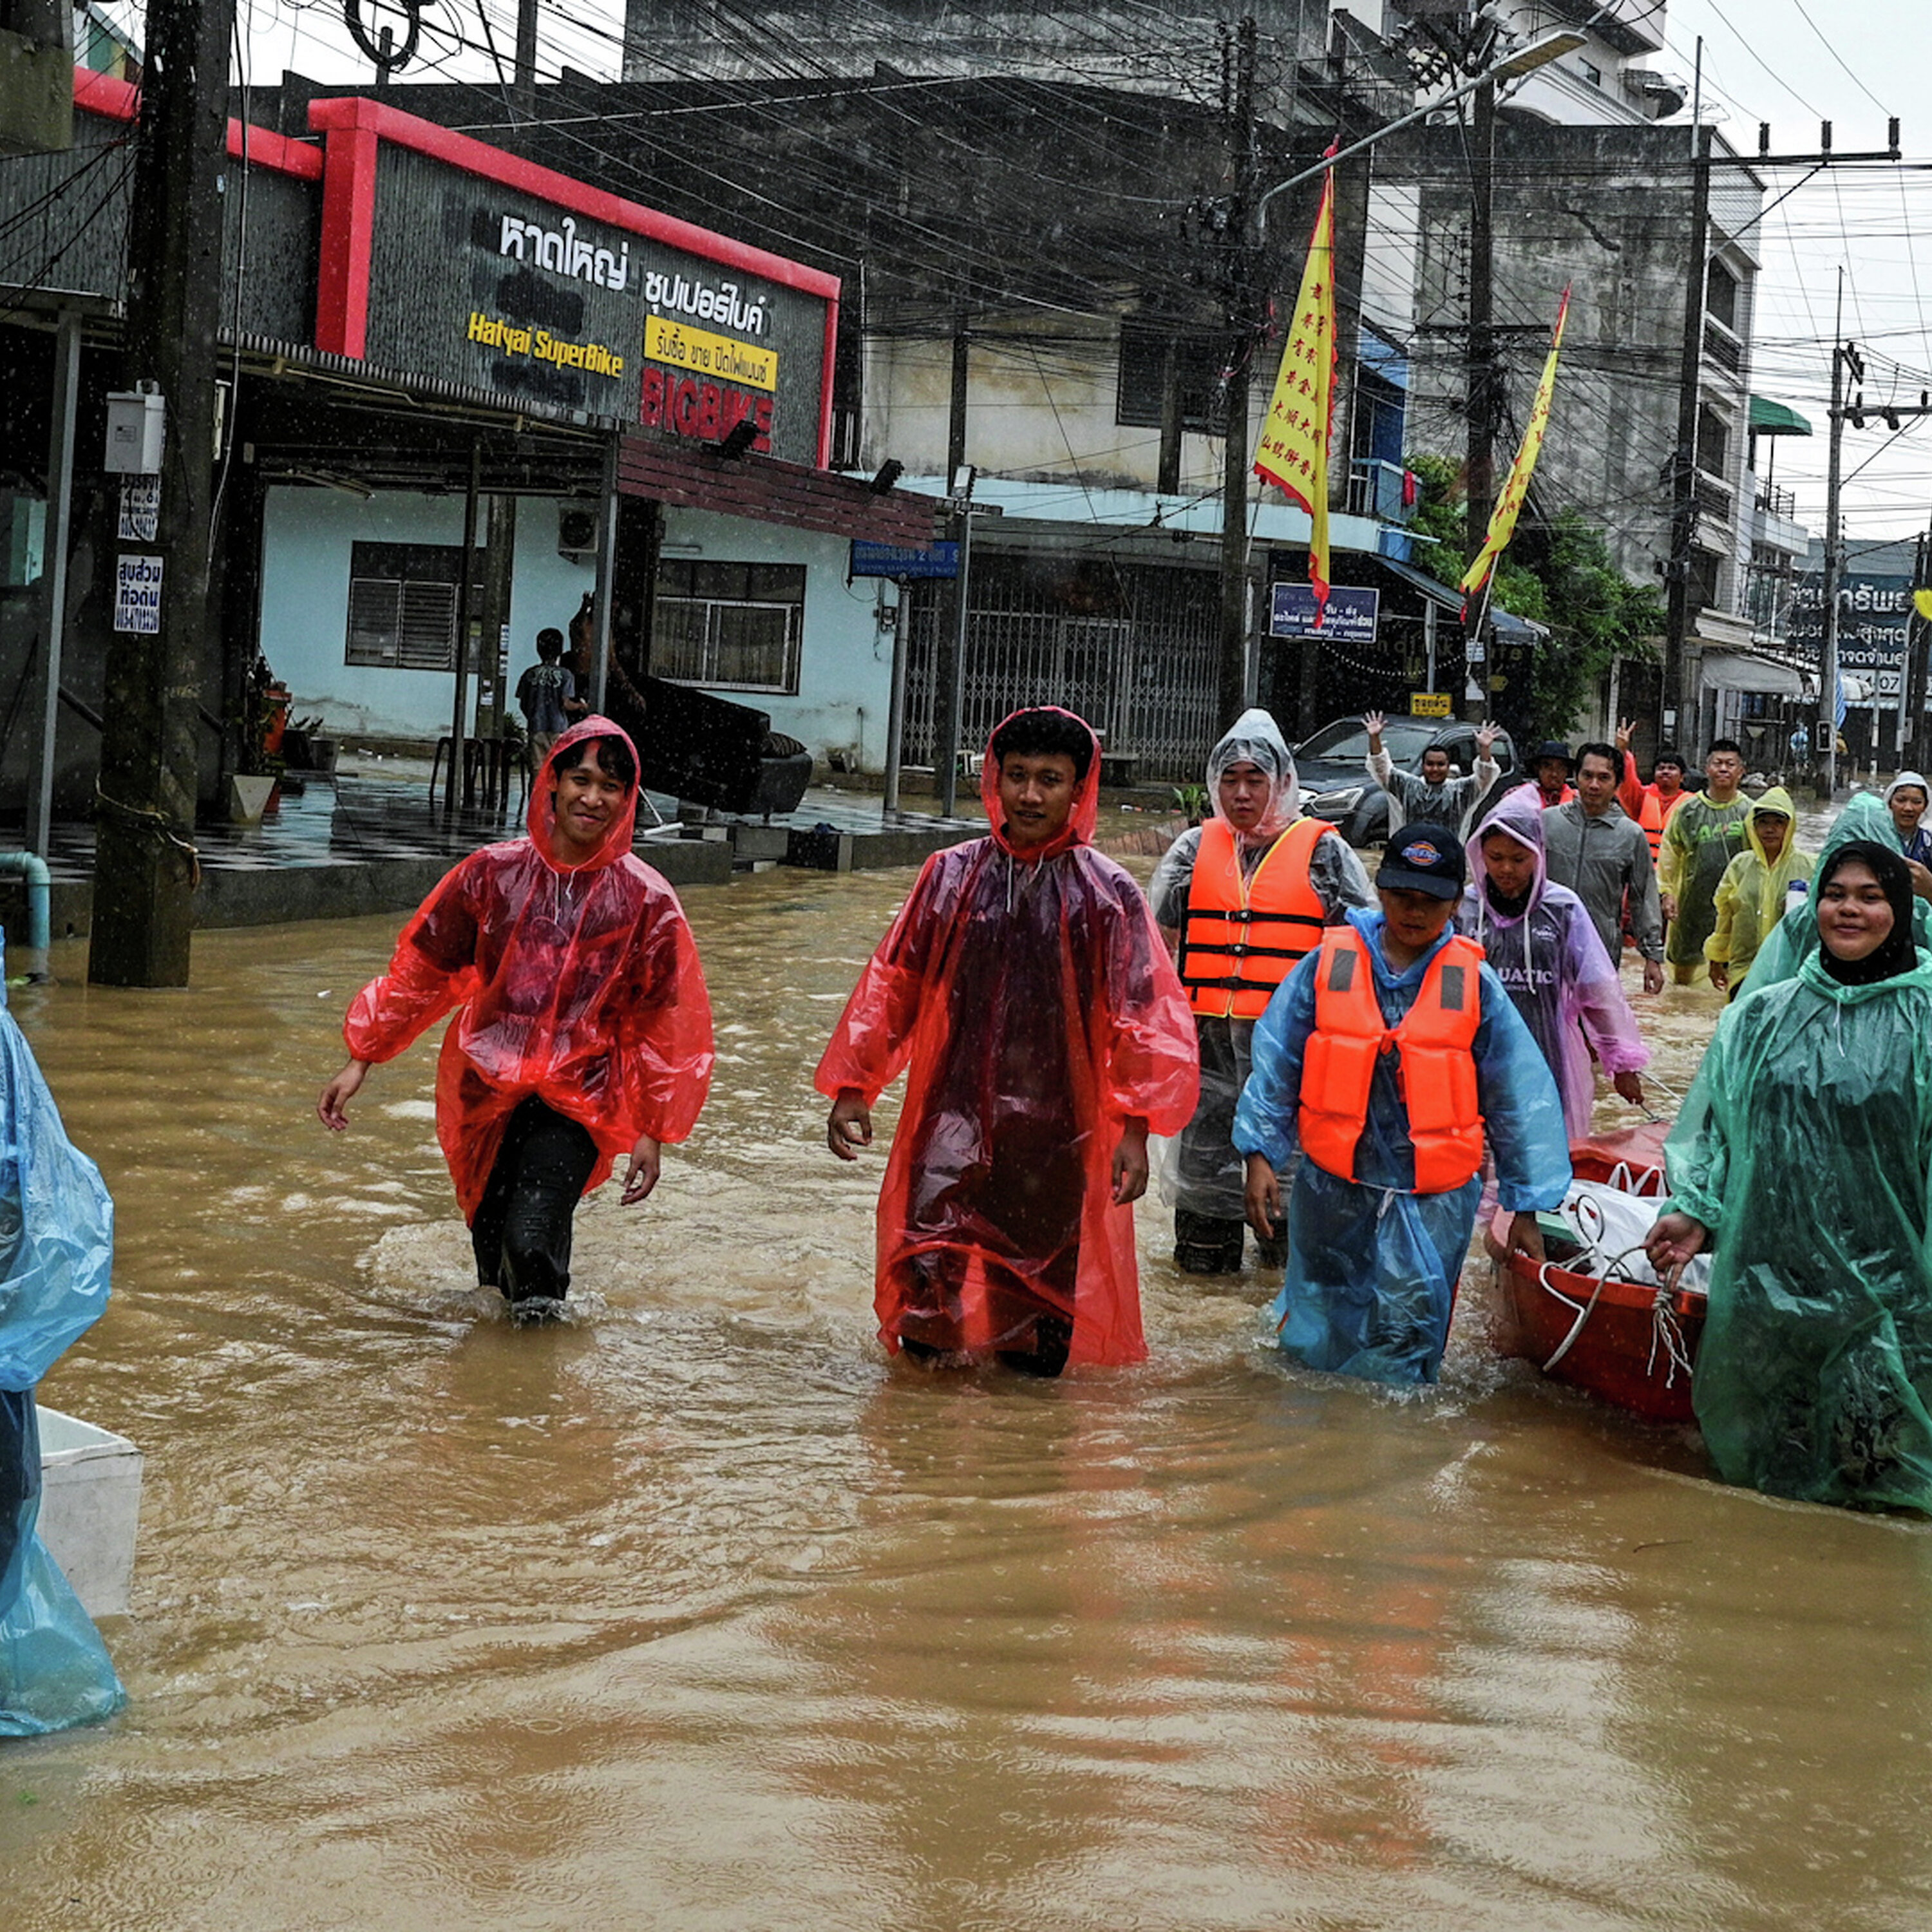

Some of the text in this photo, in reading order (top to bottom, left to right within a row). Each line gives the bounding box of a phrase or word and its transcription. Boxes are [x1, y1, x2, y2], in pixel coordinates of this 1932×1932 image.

[500, 214, 629, 291] หาดใหญ่
[468, 312, 623, 378] Hatyai SuperBike
[691, 345, 711, 367] ขาย
[640, 368, 775, 453] BIGBIKE
[1497, 967, 1553, 985] UATIC
